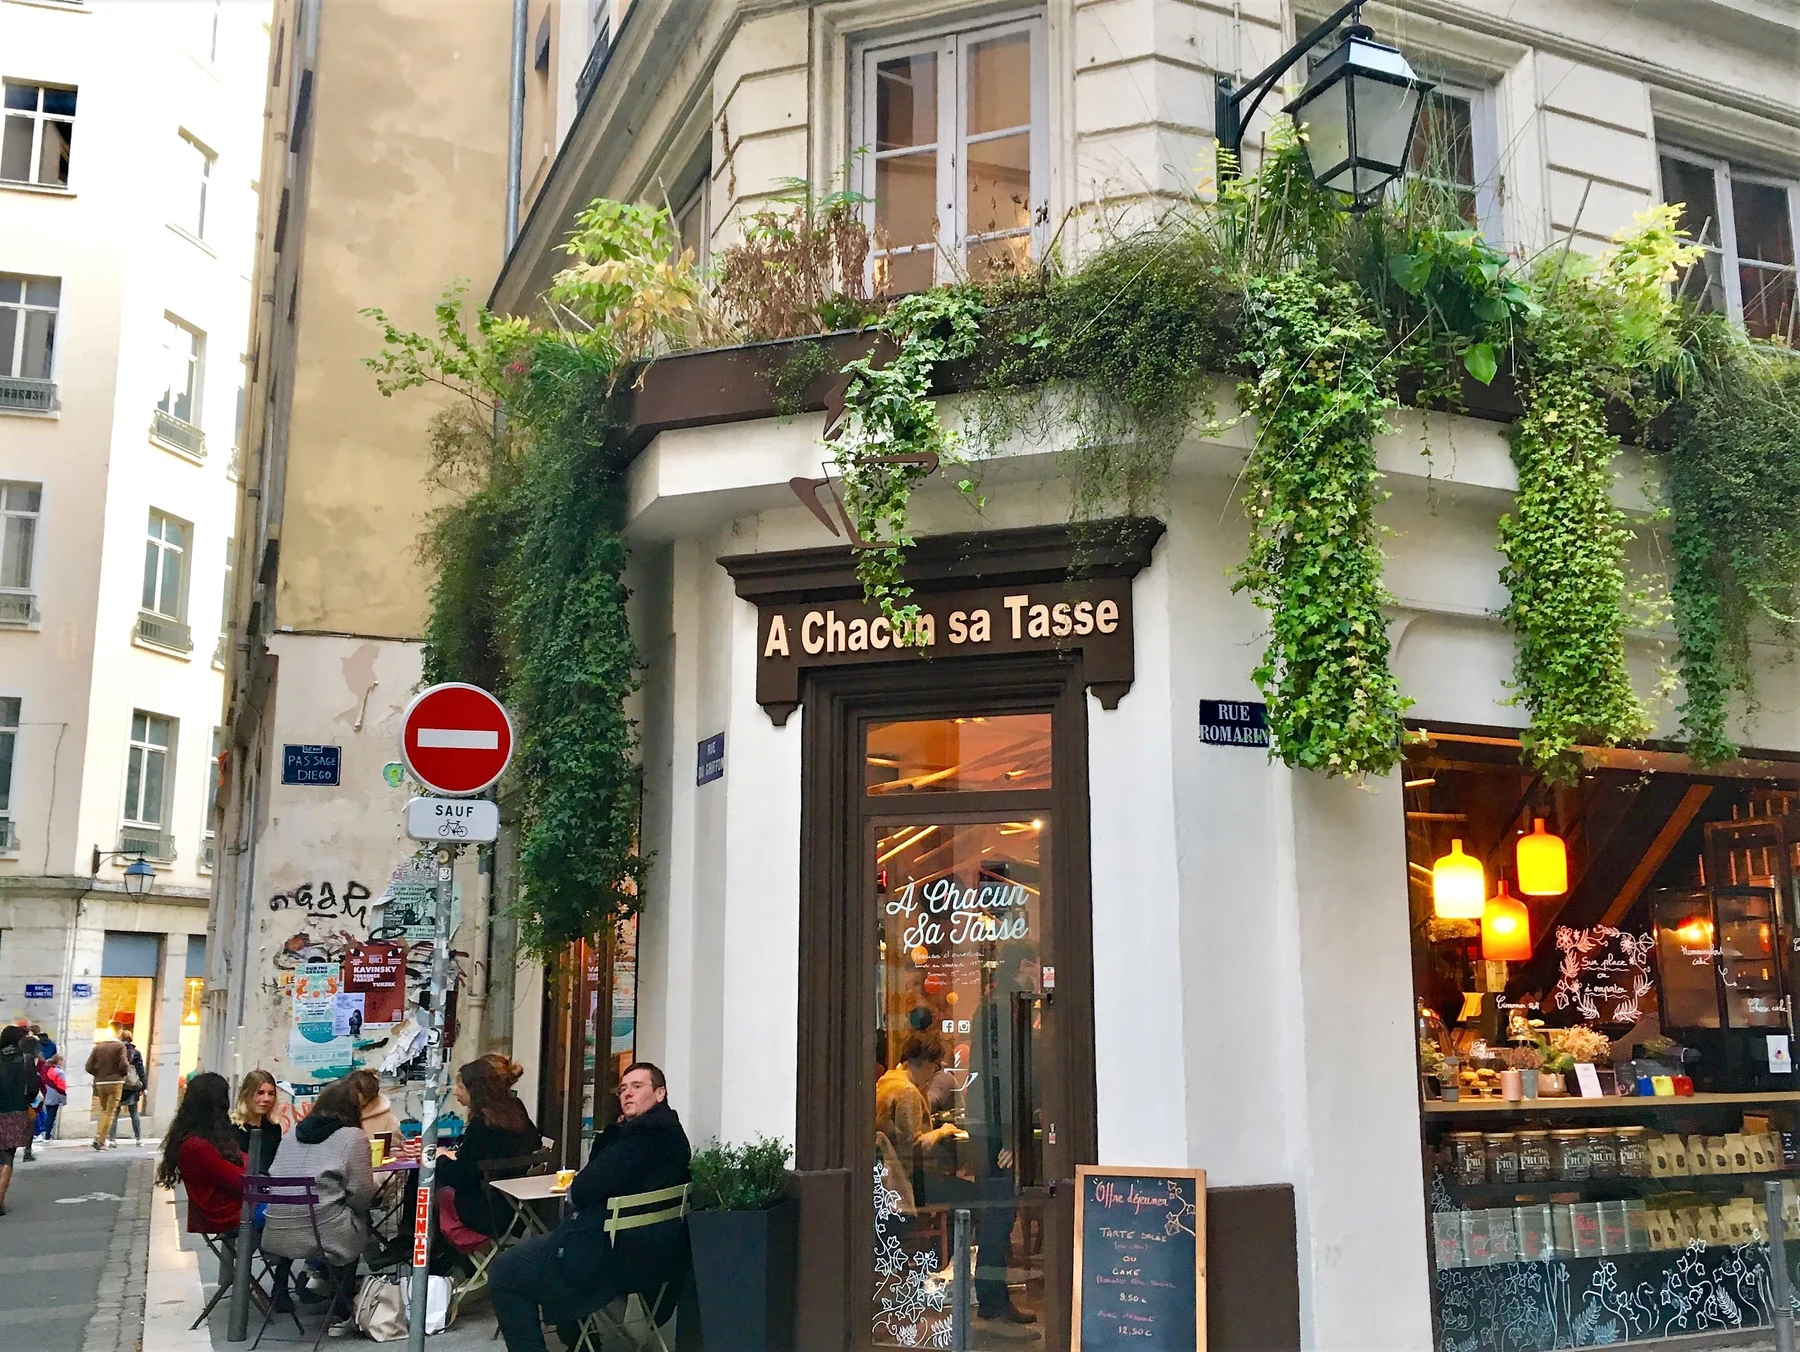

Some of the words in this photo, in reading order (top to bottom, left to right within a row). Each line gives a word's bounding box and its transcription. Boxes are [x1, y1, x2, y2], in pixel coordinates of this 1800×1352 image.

[764, 614, 790, 657] A
[800, 609, 936, 655] Chacun
[948, 609, 991, 645] sa
[1003, 594, 1119, 640] Tasse
[1217, 703, 1250, 721] RUE
[1199, 724, 1269, 744] ROMARIN
[297, 769, 332, 781] DIEGO
[435, 804, 474, 817] SAUF
[886, 875, 918, 918] À
[923, 879, 1030, 914] Chacun
[903, 912, 945, 954] Sa
[950, 911, 1029, 945] Tasse
[1581, 956, 1599, 966] Sur
[1600, 952, 1628, 971] place
[1095, 1181, 1125, 1209] Offre
[414, 1188, 429, 1266] SONIC
[1099, 1227, 1135, 1239] TARTE
[1112, 1268, 1141, 1276] CAKE
